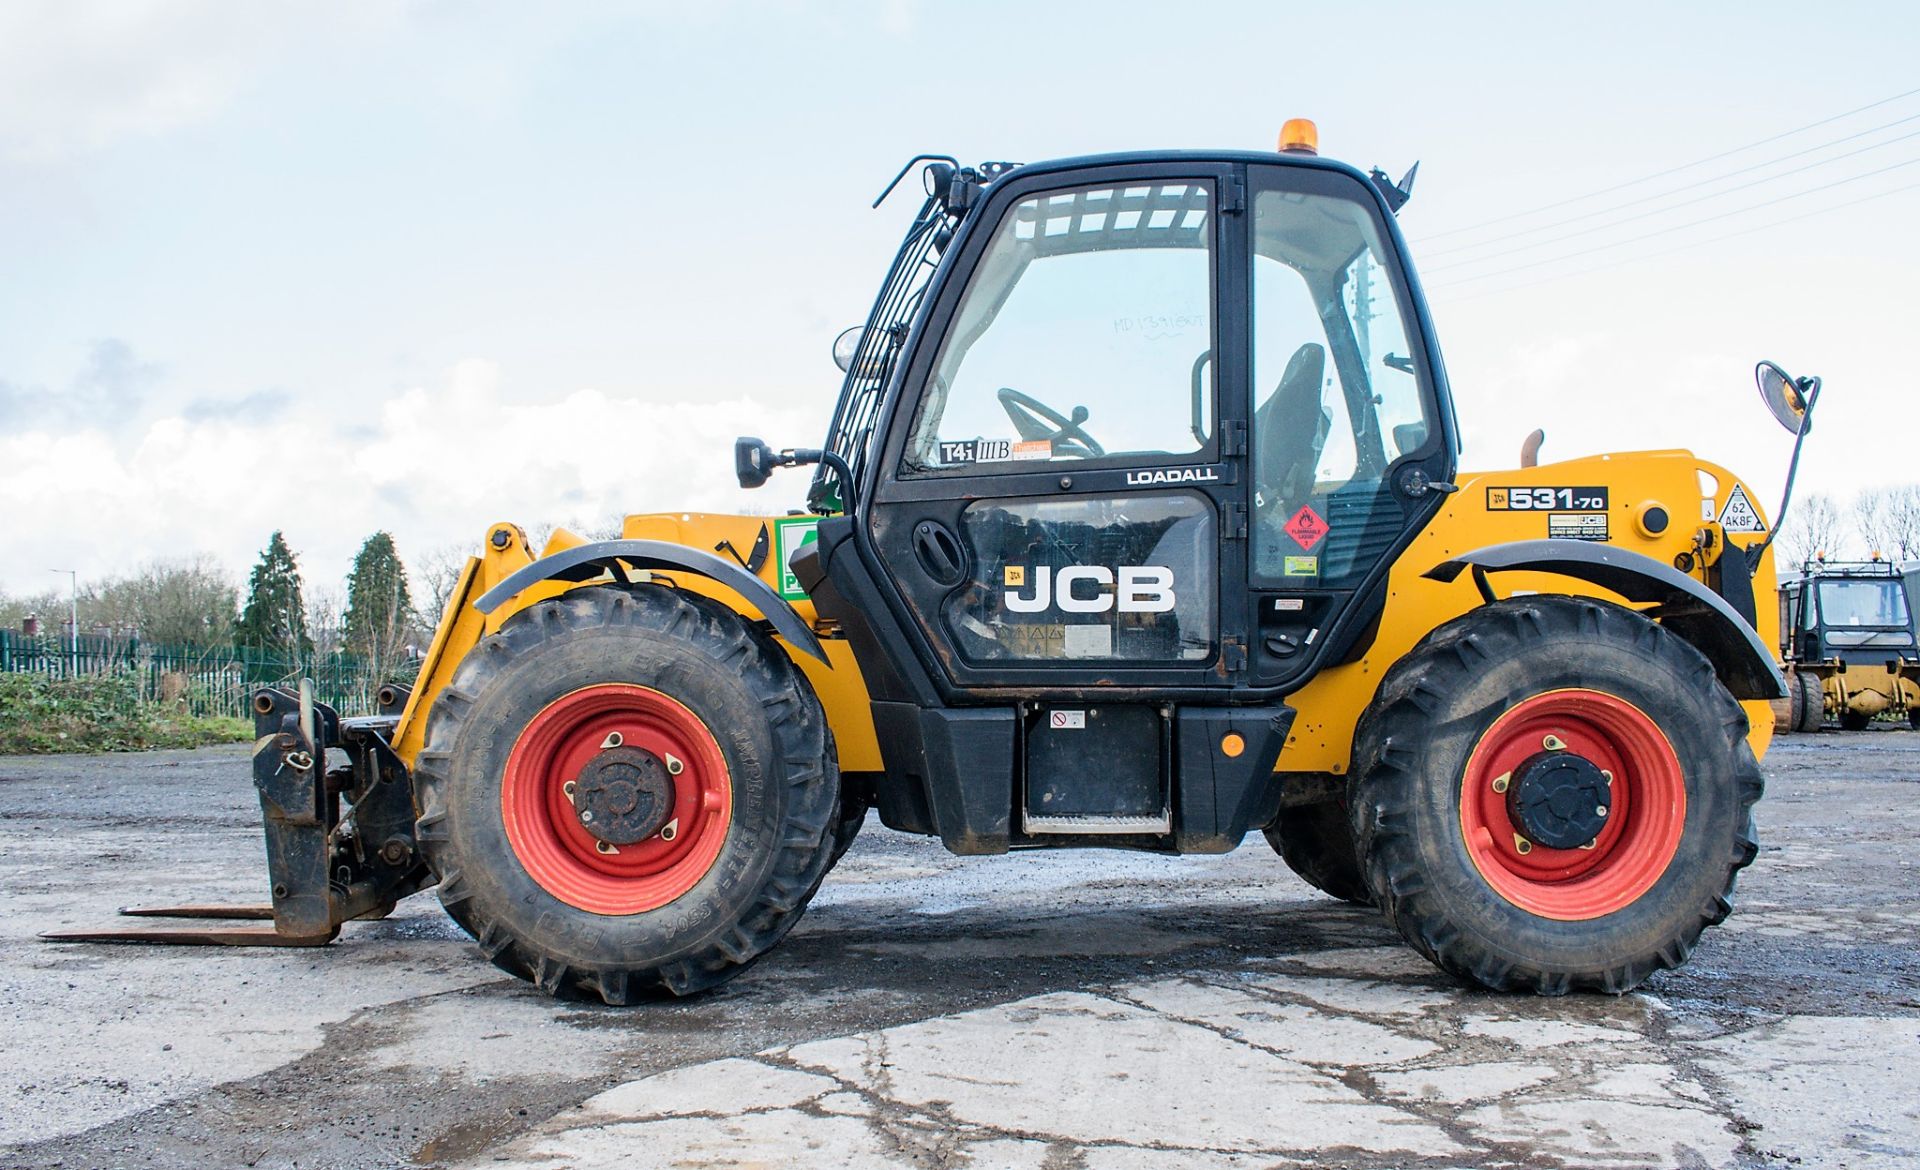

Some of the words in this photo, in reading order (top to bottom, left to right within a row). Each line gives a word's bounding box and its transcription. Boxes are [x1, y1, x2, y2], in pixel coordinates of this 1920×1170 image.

[942, 443, 975, 462] T4i
[1127, 468, 1219, 485] LOADALL
[1732, 502, 1746, 513] 62
[1581, 516, 1604, 525] JCB
[1725, 515, 1753, 527] AK8F
[1004, 565, 1176, 613] JCB
